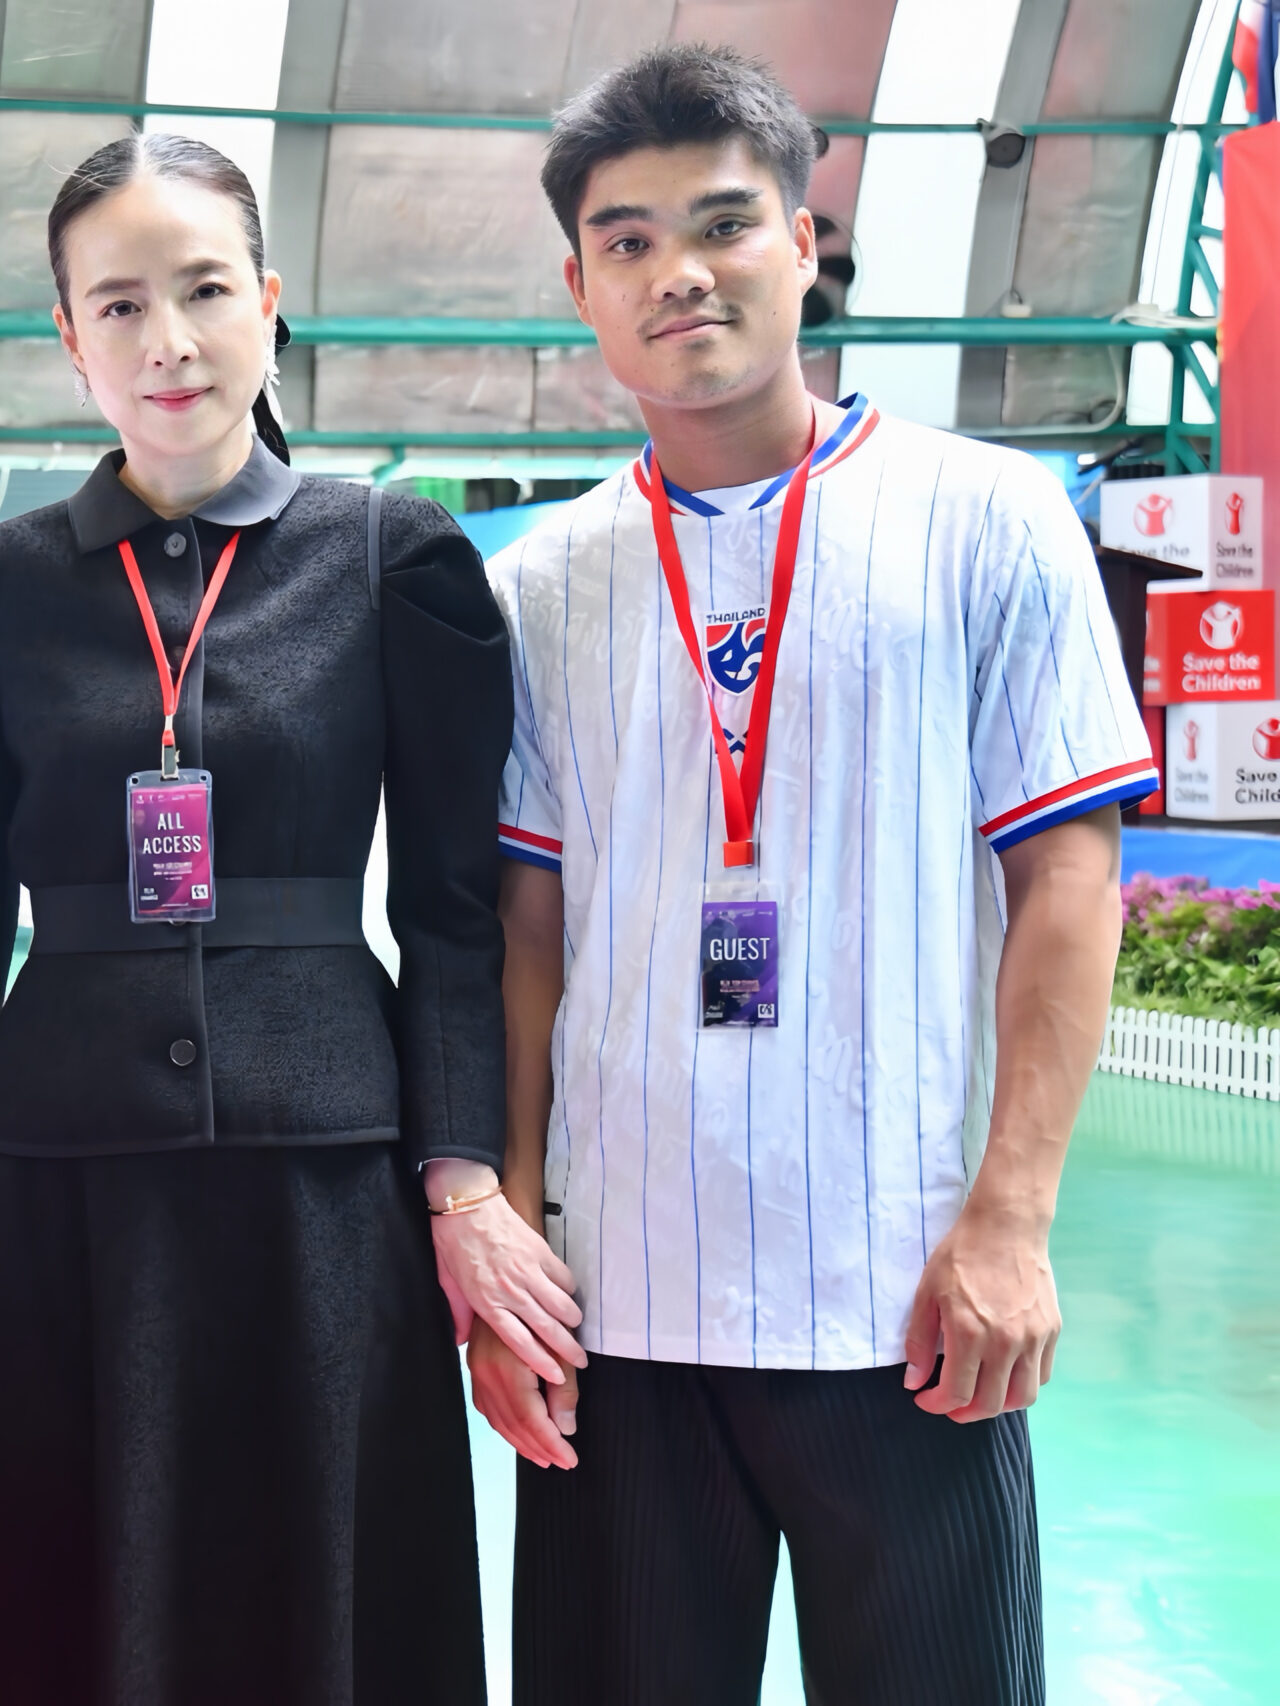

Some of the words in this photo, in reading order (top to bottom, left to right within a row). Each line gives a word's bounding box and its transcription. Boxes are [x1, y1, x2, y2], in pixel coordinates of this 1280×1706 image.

[706, 607, 766, 624] THAILAND
[1182, 652, 1225, 672] Save
[1229, 652, 1260, 671] the
[1181, 673, 1261, 693] Children
[1235, 767, 1278, 785] Save
[157, 812, 184, 831] ALL
[142, 835, 203, 855] ACCESS
[710, 937, 771, 961] GUEST
